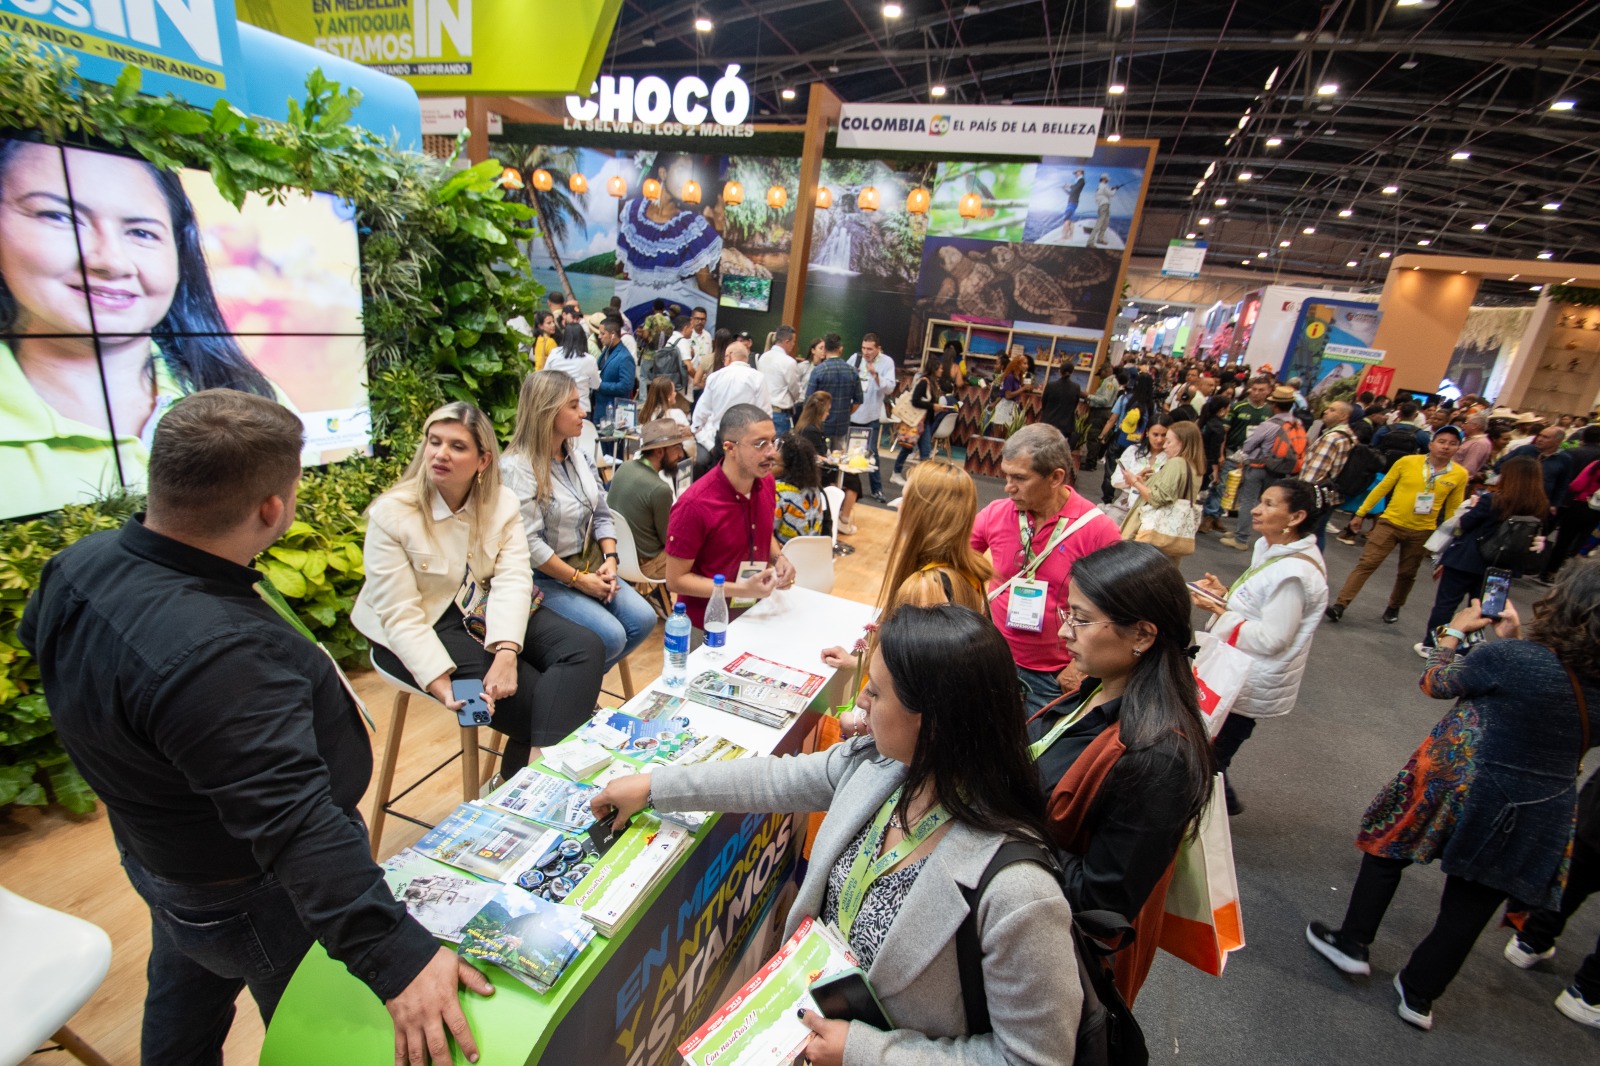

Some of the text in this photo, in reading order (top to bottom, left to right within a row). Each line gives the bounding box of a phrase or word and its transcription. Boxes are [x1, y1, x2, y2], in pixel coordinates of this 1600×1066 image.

[314, 13, 411, 34] Y ANTIOQUIA
[315, 0, 472, 61] ESTAMOS IN
[107, 43, 217, 85] INSPIRANDO
[418, 63, 468, 75] INSPIRANDO
[565, 64, 750, 126] CHOCÓ
[564, 118, 755, 138] LA SELVA DE LOS 2 MARES
[841, 117, 926, 133] COLOMBIA
[953, 120, 966, 131] EL
[969, 117, 998, 132] PAÍS
[1001, 121, 1017, 133] DE
[1021, 121, 1037, 134] LA
[1041, 122, 1097, 136] BELLEZA
[616, 924, 669, 1031] EN
[616, 1000, 646, 1060] Y
[705, 1051, 720, 1066] Con
[720, 1010, 758, 1053] nosotros!!!
